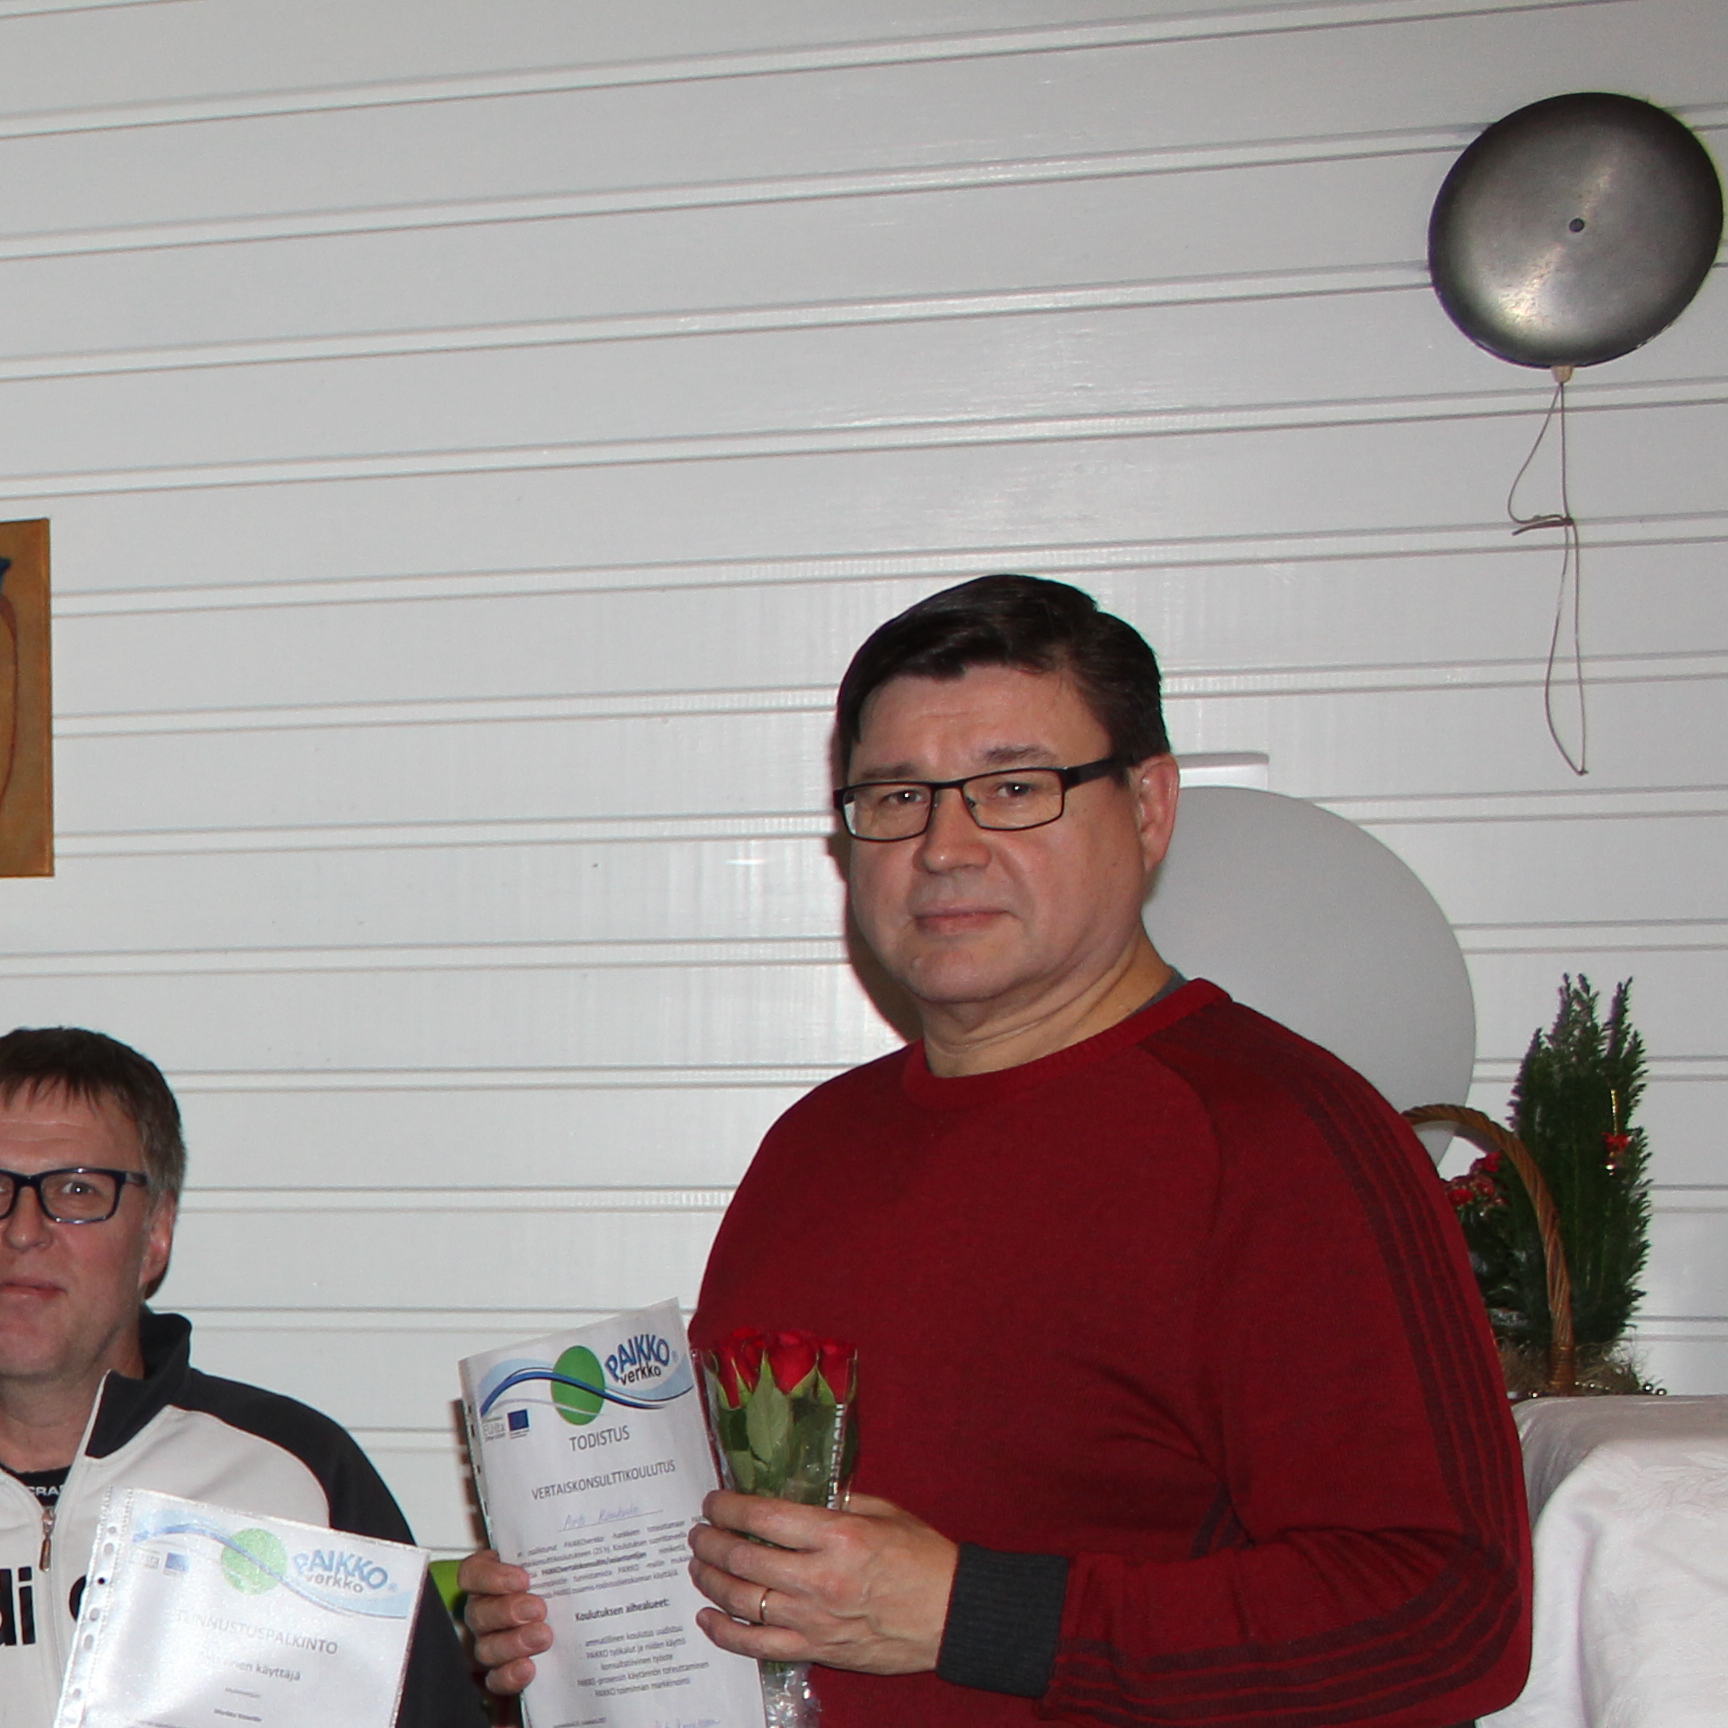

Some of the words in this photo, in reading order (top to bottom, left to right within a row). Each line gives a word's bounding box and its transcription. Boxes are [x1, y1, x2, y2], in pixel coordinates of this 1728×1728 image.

[605, 1333, 670, 1382] PAIKKO
[619, 1362, 662, 1386] verkko
[569, 1425, 630, 1451] TODISTUS
[531, 1460, 676, 1501] VERTAISKONSULTTIKOULUTUS
[294, 1549, 389, 1590] PAIKKO
[305, 1571, 365, 1594] verkko
[575, 1606, 623, 1621] Koulutuksen
